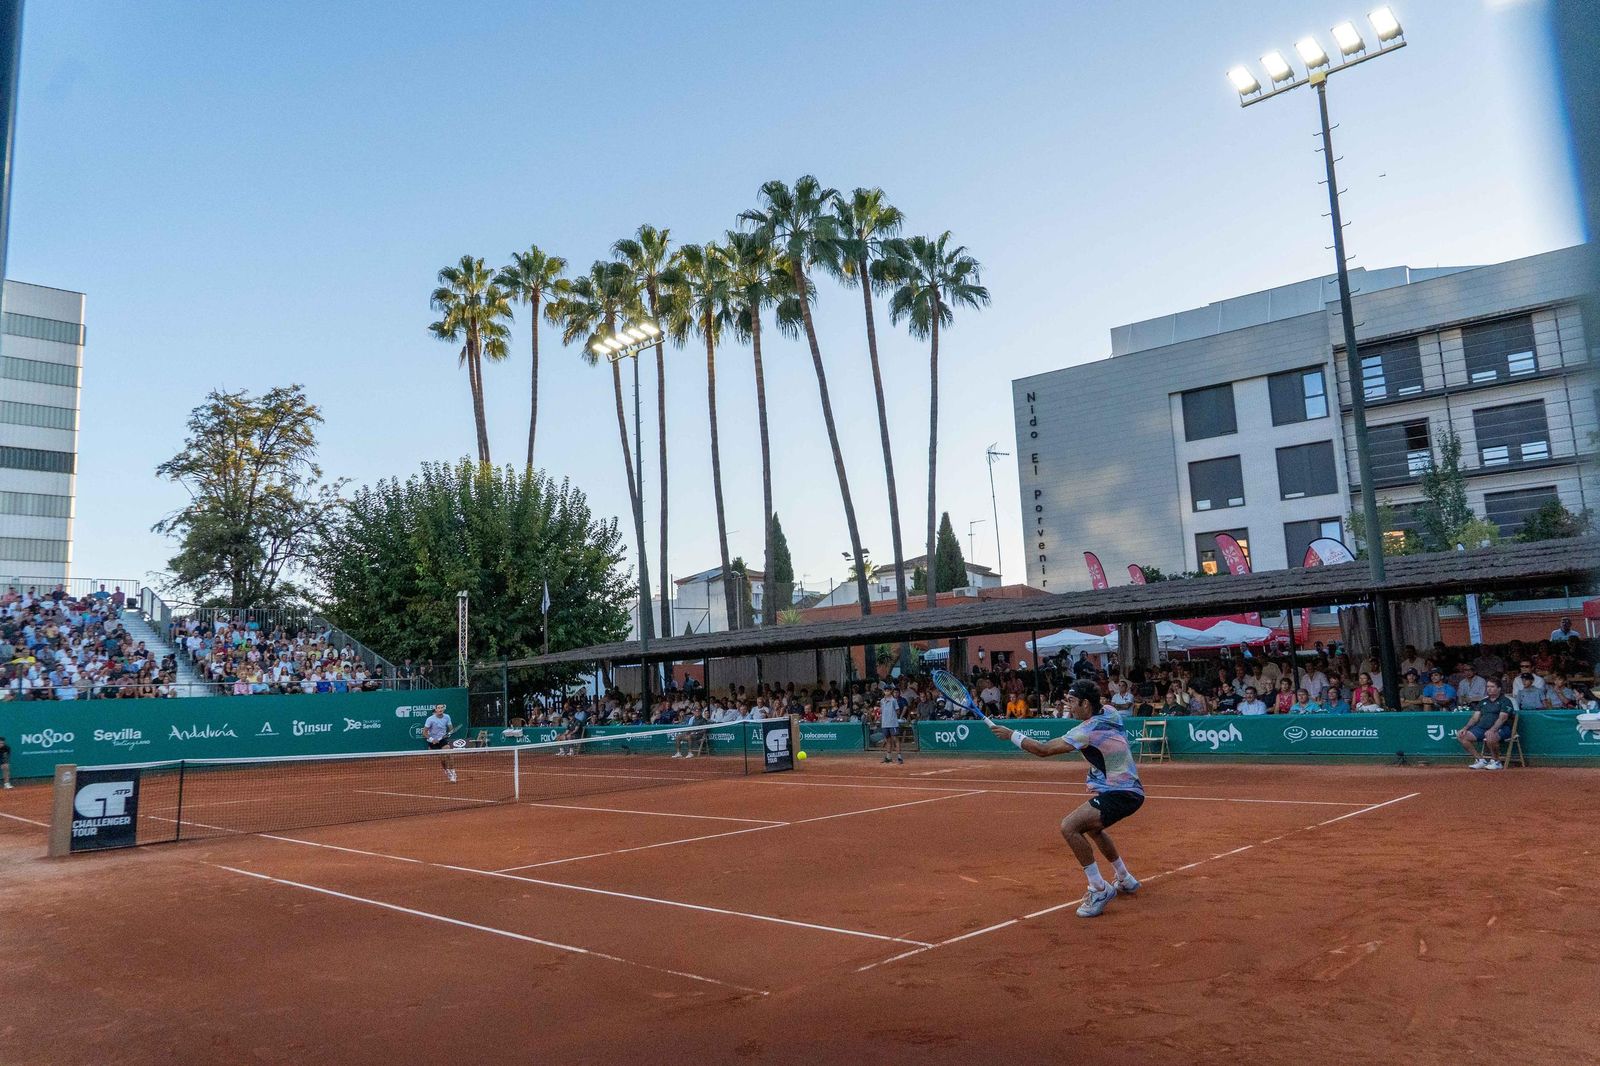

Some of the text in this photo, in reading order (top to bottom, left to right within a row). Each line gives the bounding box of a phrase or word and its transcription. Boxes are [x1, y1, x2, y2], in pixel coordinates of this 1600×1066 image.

[1027, 391, 1048, 588] Nido El Porvenir
[94, 728, 142, 741] Sevilla
[168, 723, 239, 740] Andalucía
[935, 731, 957, 743] FOX
[1188, 722, 1243, 750] lagoh
[1310, 727, 1379, 737] solocanarias
[72, 816, 131, 829] CHALLENGER
[72, 827, 98, 837] TOUR
